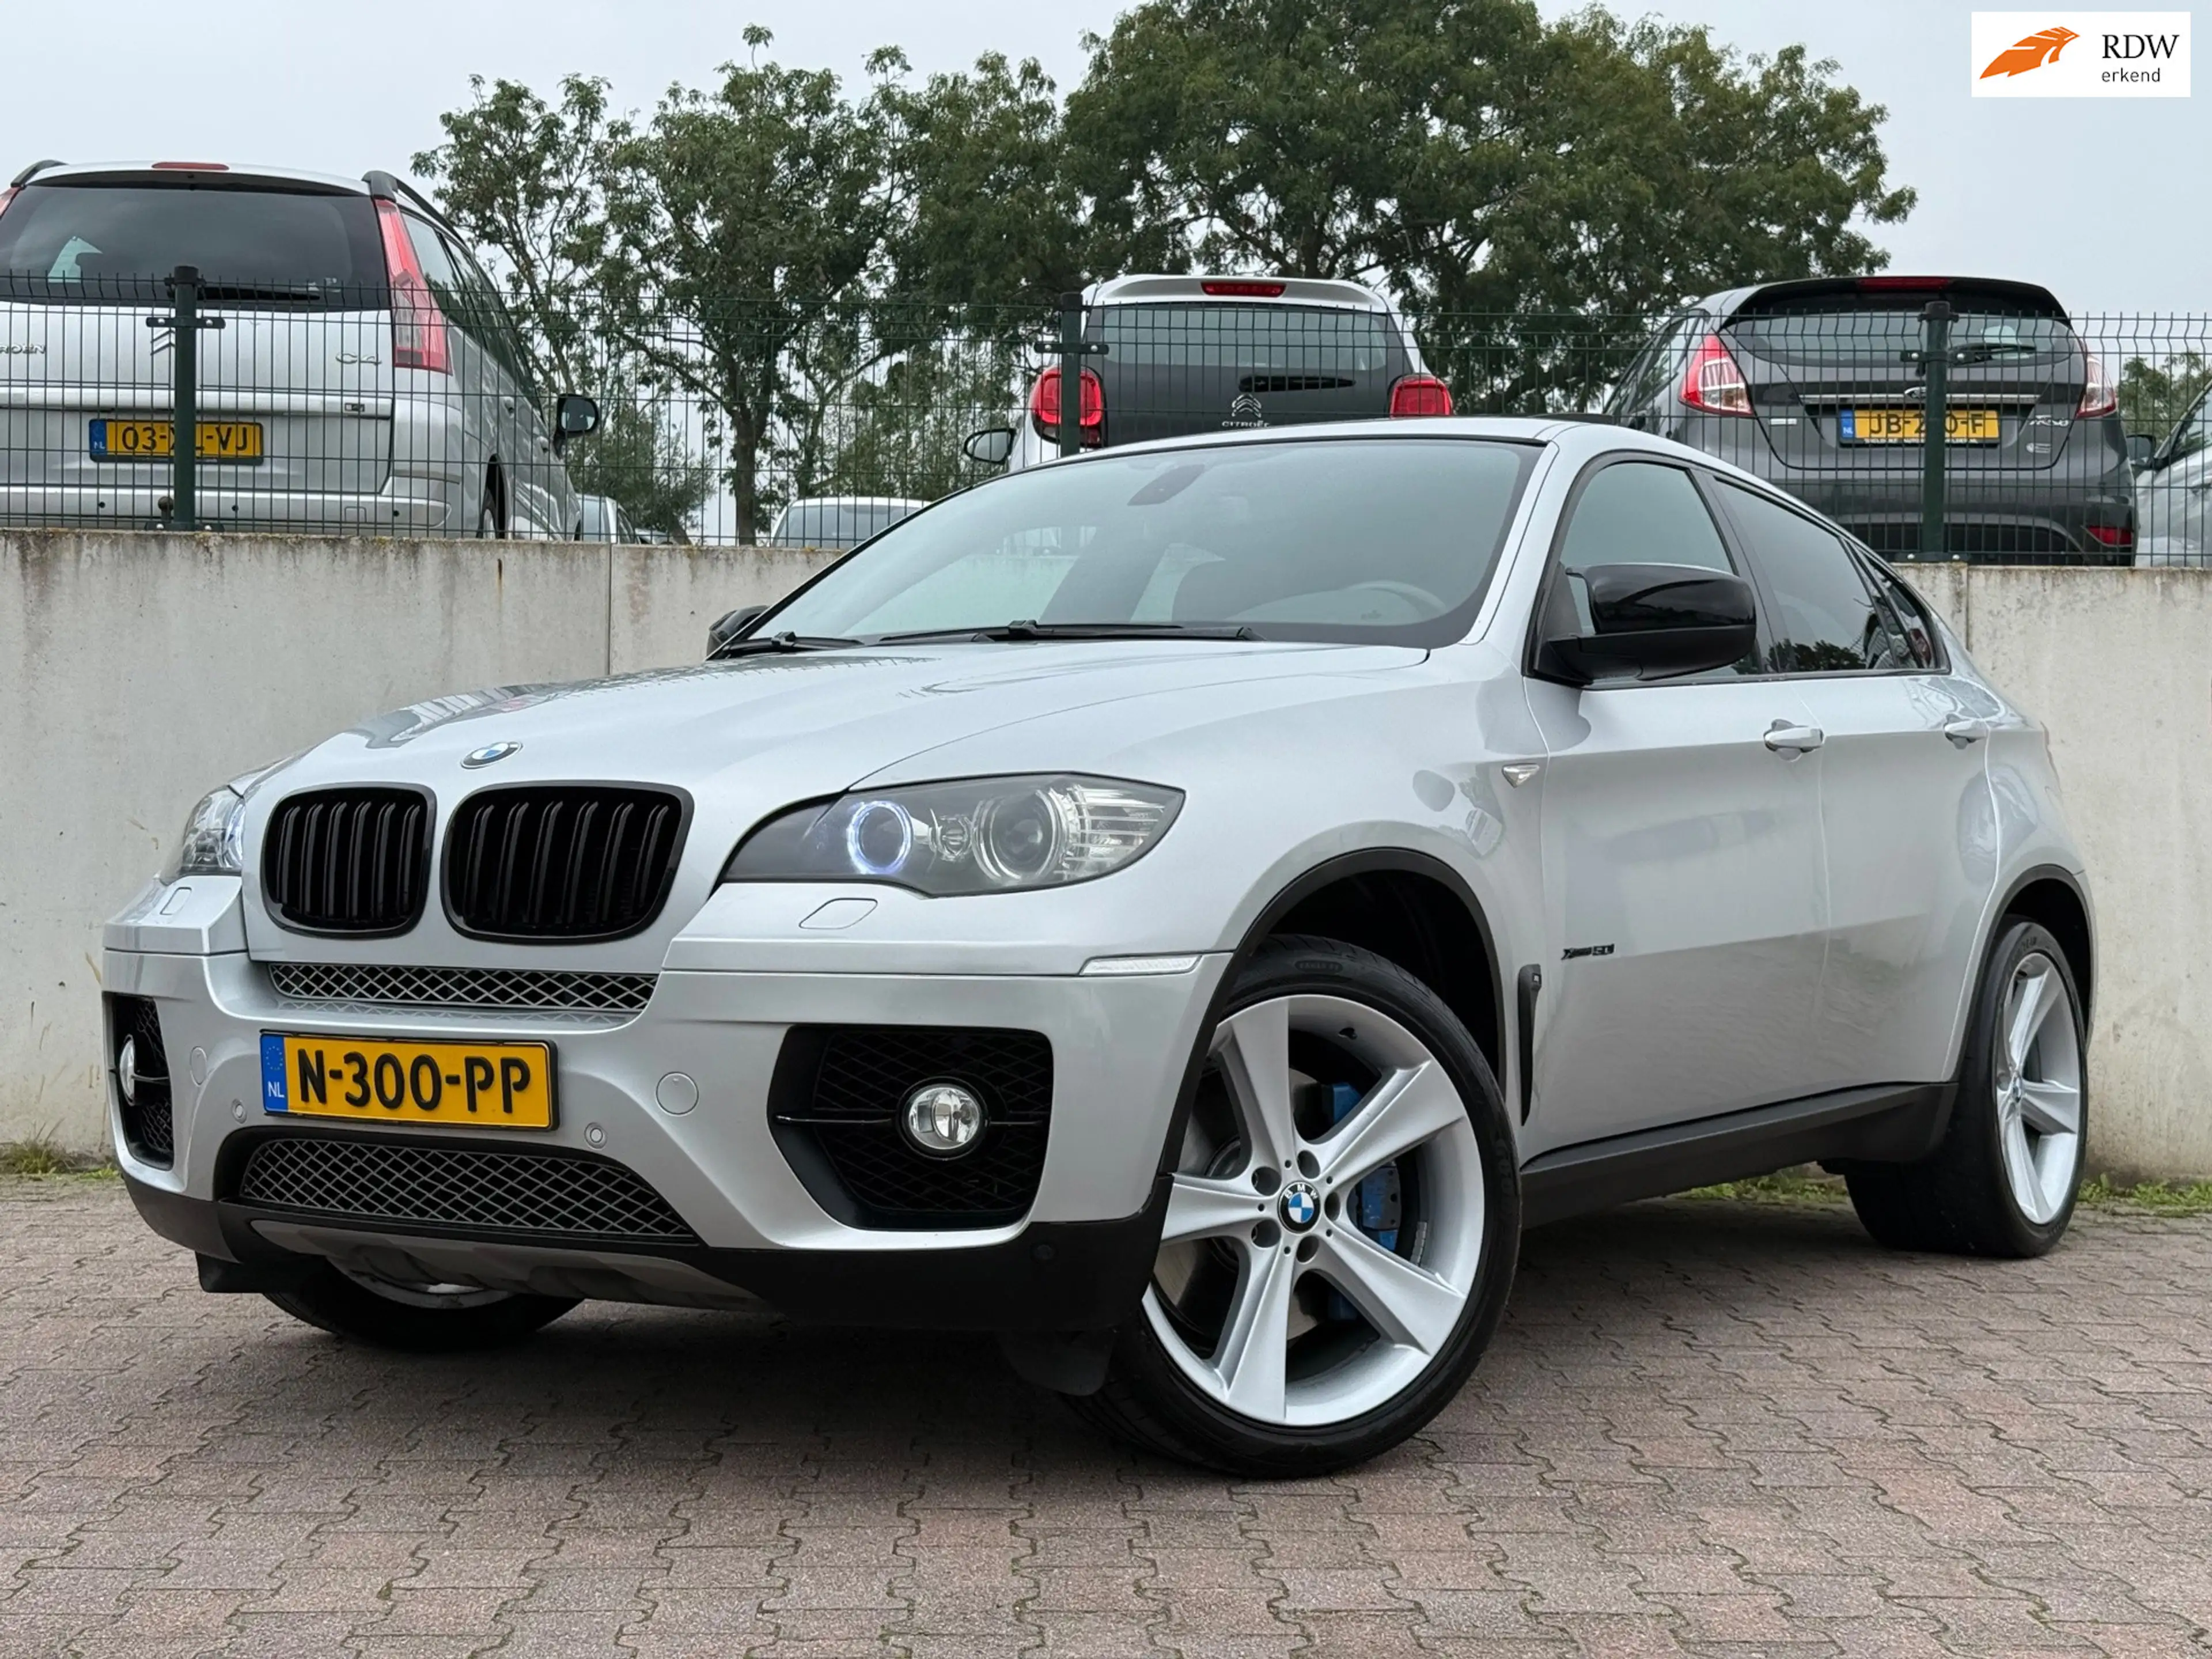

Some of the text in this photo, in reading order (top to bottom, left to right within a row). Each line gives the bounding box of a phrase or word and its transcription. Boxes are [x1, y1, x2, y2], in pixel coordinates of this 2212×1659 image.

[1870, 413, 1983, 434] JB-20-F
[122, 426, 247, 451] 03--VJ
[267, 1081, 285, 1099] NL
[297, 1048, 531, 1114] N-300-PP
[1283, 1183, 1318, 1199] BMW
